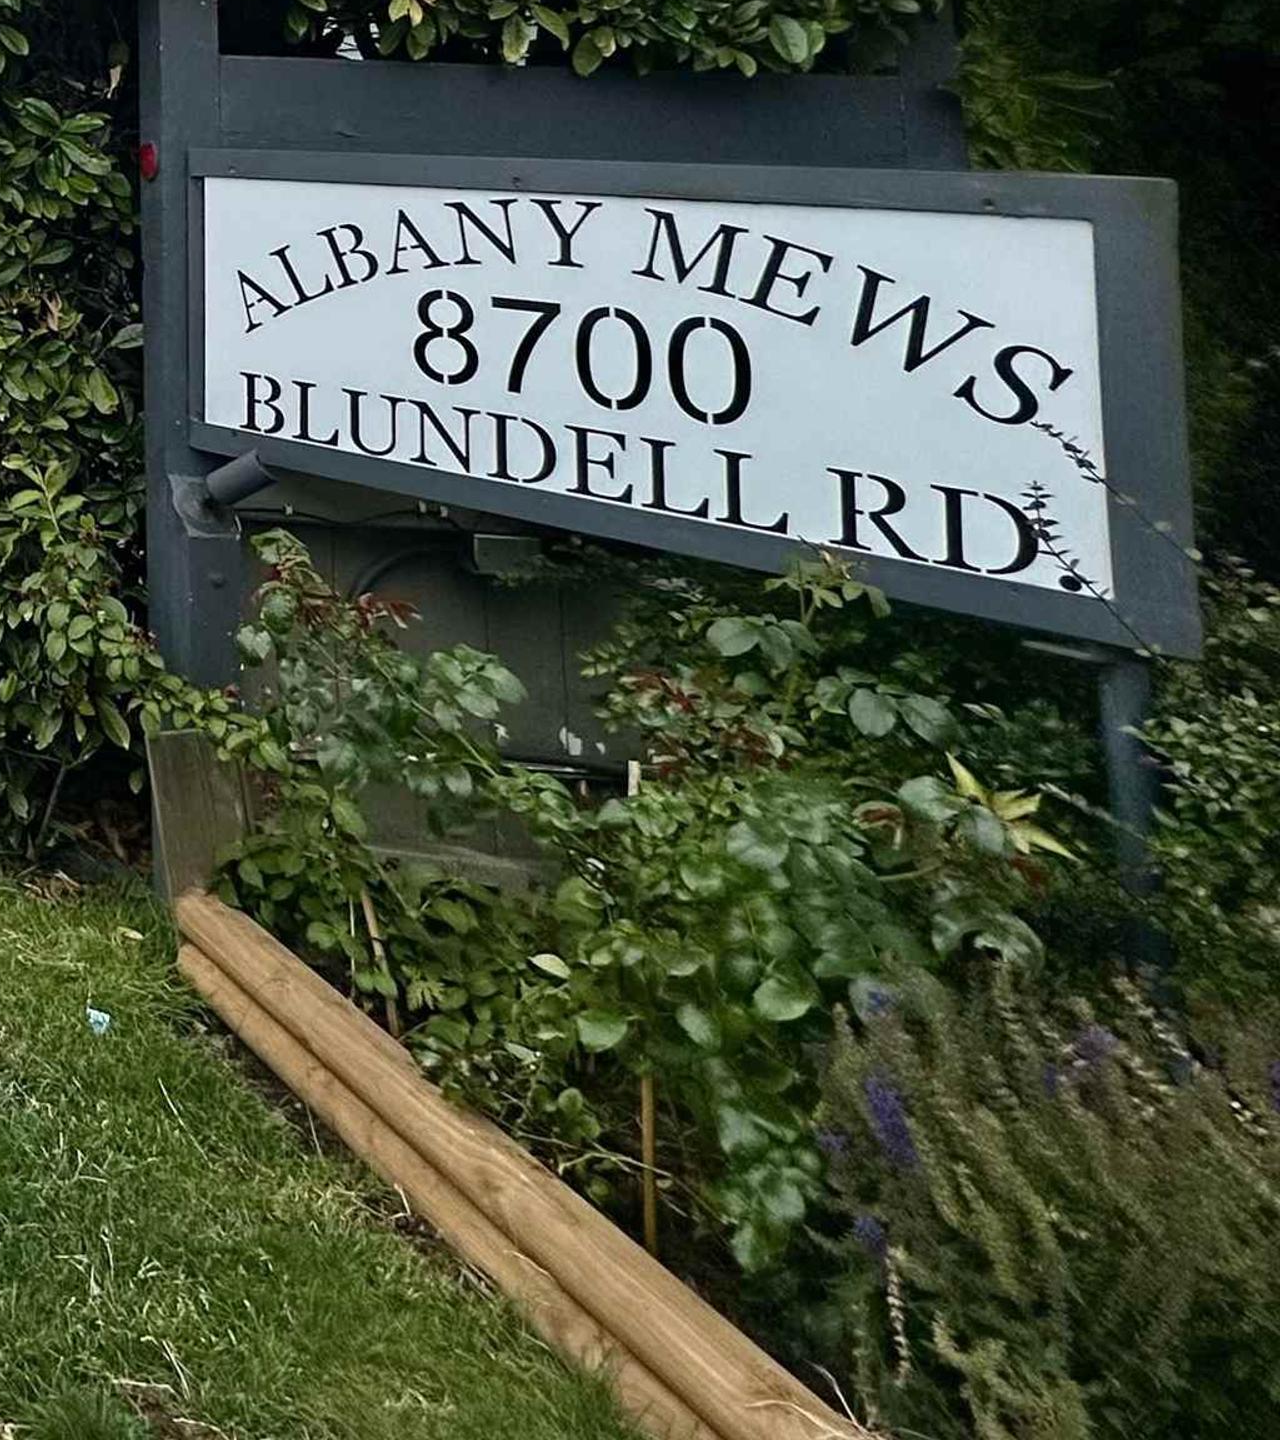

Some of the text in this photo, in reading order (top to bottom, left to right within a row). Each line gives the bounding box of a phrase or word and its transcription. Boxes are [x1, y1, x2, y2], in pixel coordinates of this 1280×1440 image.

[238, 198, 1074, 426] ALBANY MEWS
[413, 290, 752, 426] 8700
[240, 371, 1083, 593] BLUNDELL RD.
